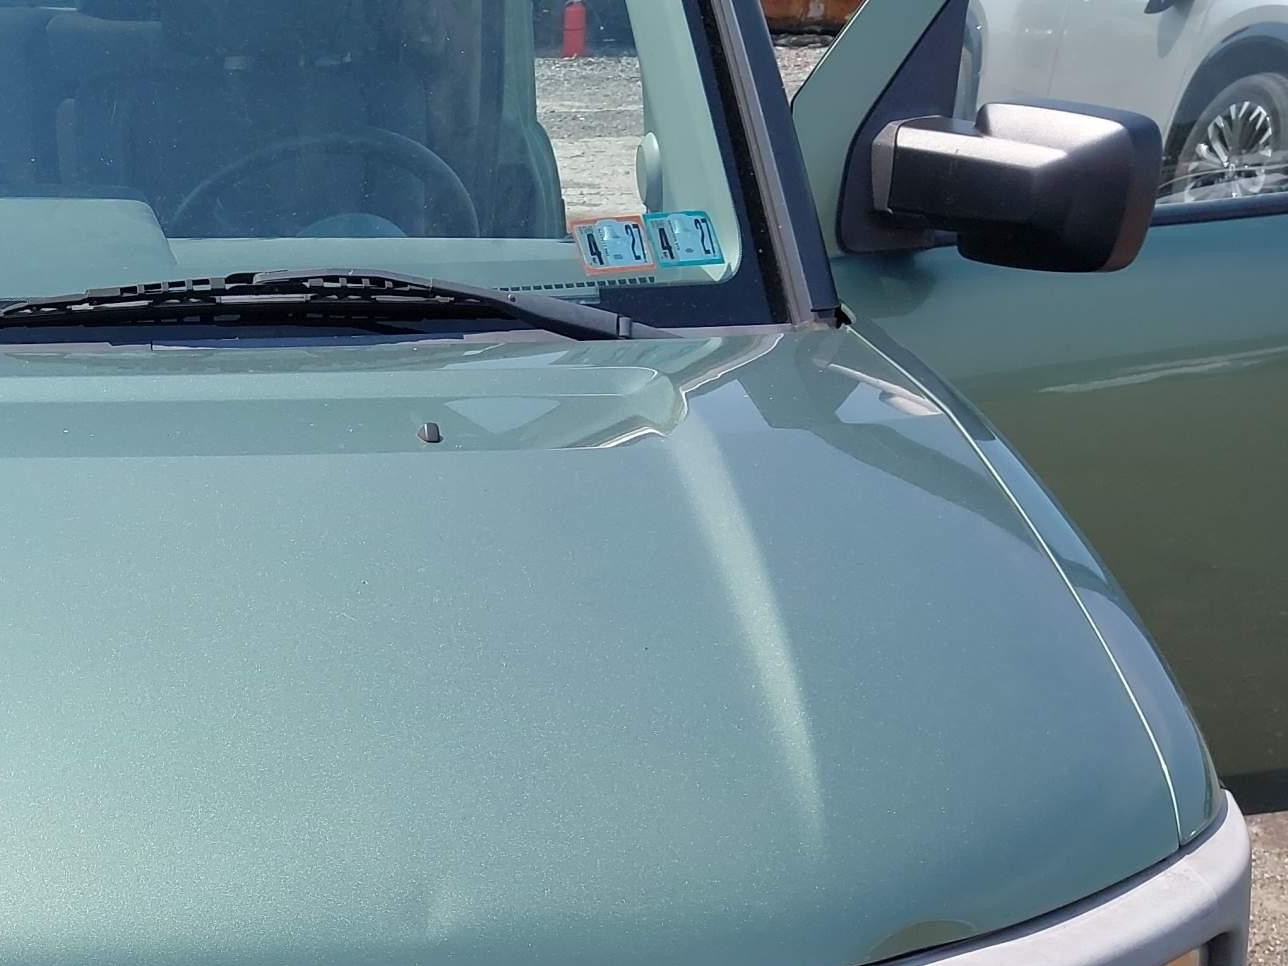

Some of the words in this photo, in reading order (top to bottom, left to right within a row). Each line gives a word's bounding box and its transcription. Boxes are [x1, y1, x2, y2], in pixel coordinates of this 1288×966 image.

[587, 233, 604, 265] 4
[624, 224, 647, 262] 27
[658, 228, 675, 259] 4
[694, 218, 716, 256] 27
